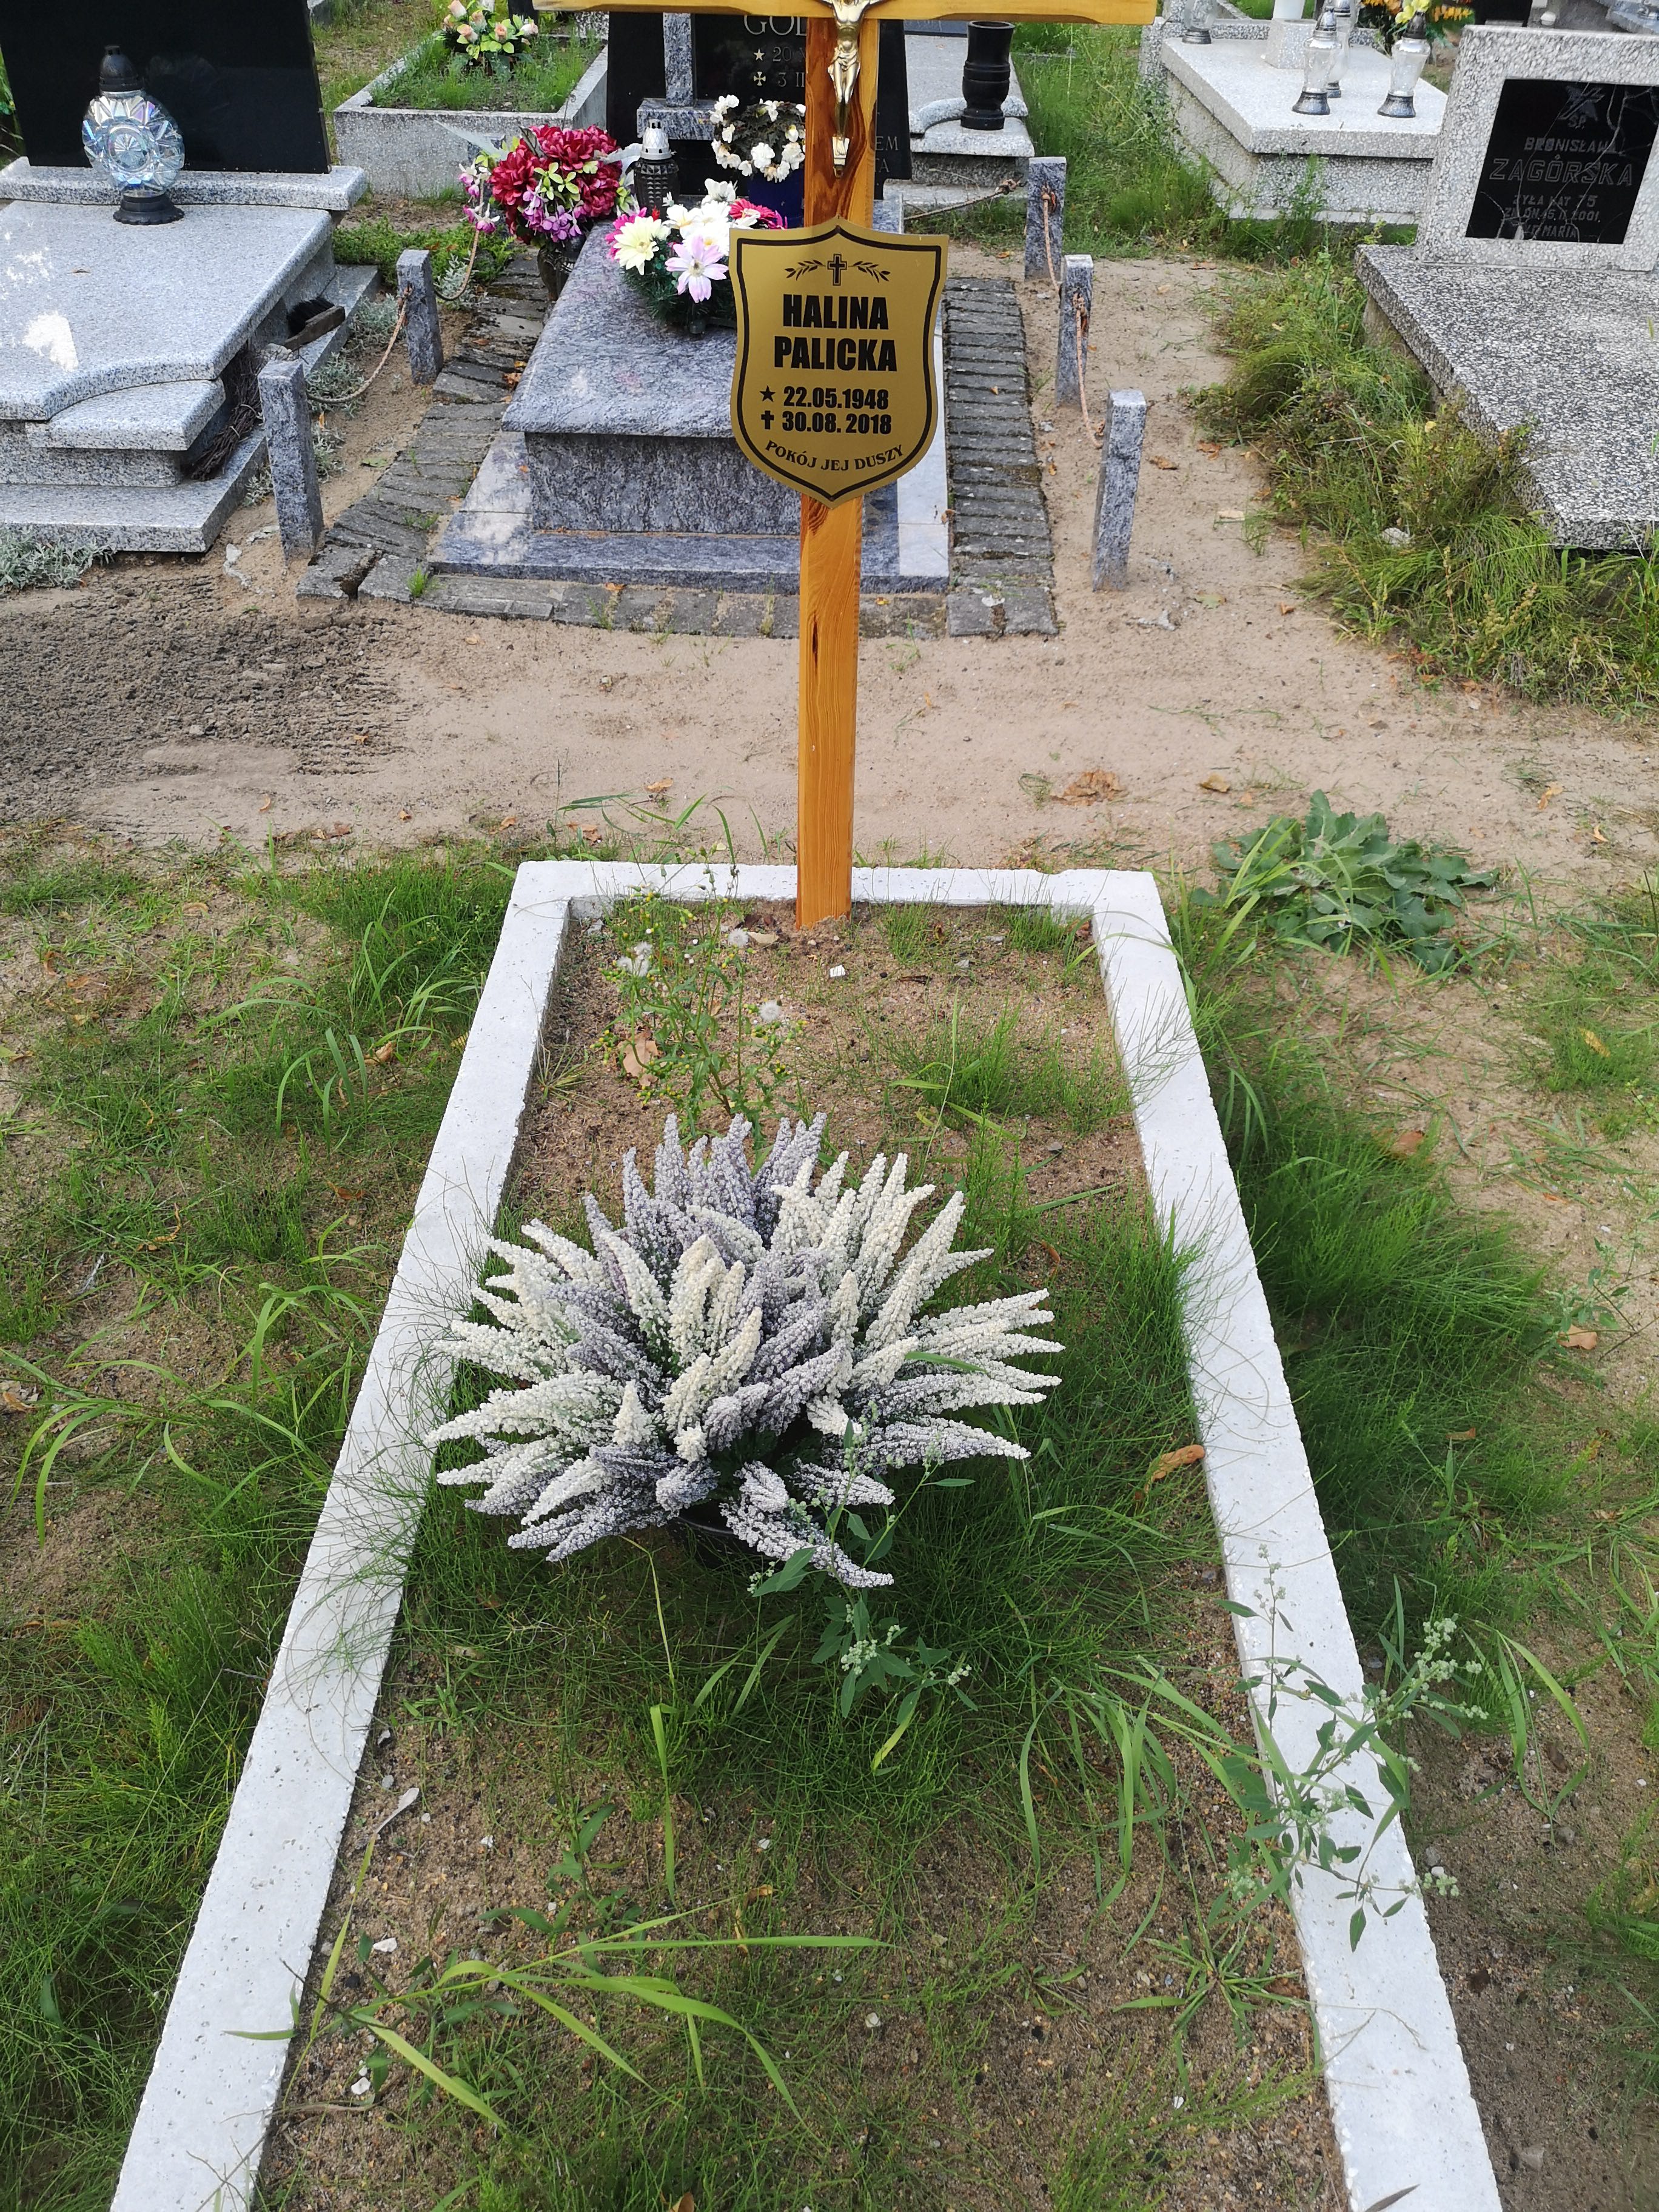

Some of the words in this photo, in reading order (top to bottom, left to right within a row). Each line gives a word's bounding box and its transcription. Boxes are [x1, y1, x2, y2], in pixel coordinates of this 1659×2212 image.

[1489, 155, 1632, 186] ZAGÓRSKA
[783, 293, 889, 330] HALINA
[774, 335, 897, 372] PALICKA
[783, 386, 889, 410] 22.05.1948
[765, 440, 817, 468] POKÓJ
[821, 459, 849, 471] JEJ
[854, 444, 904, 470] DUSZY
